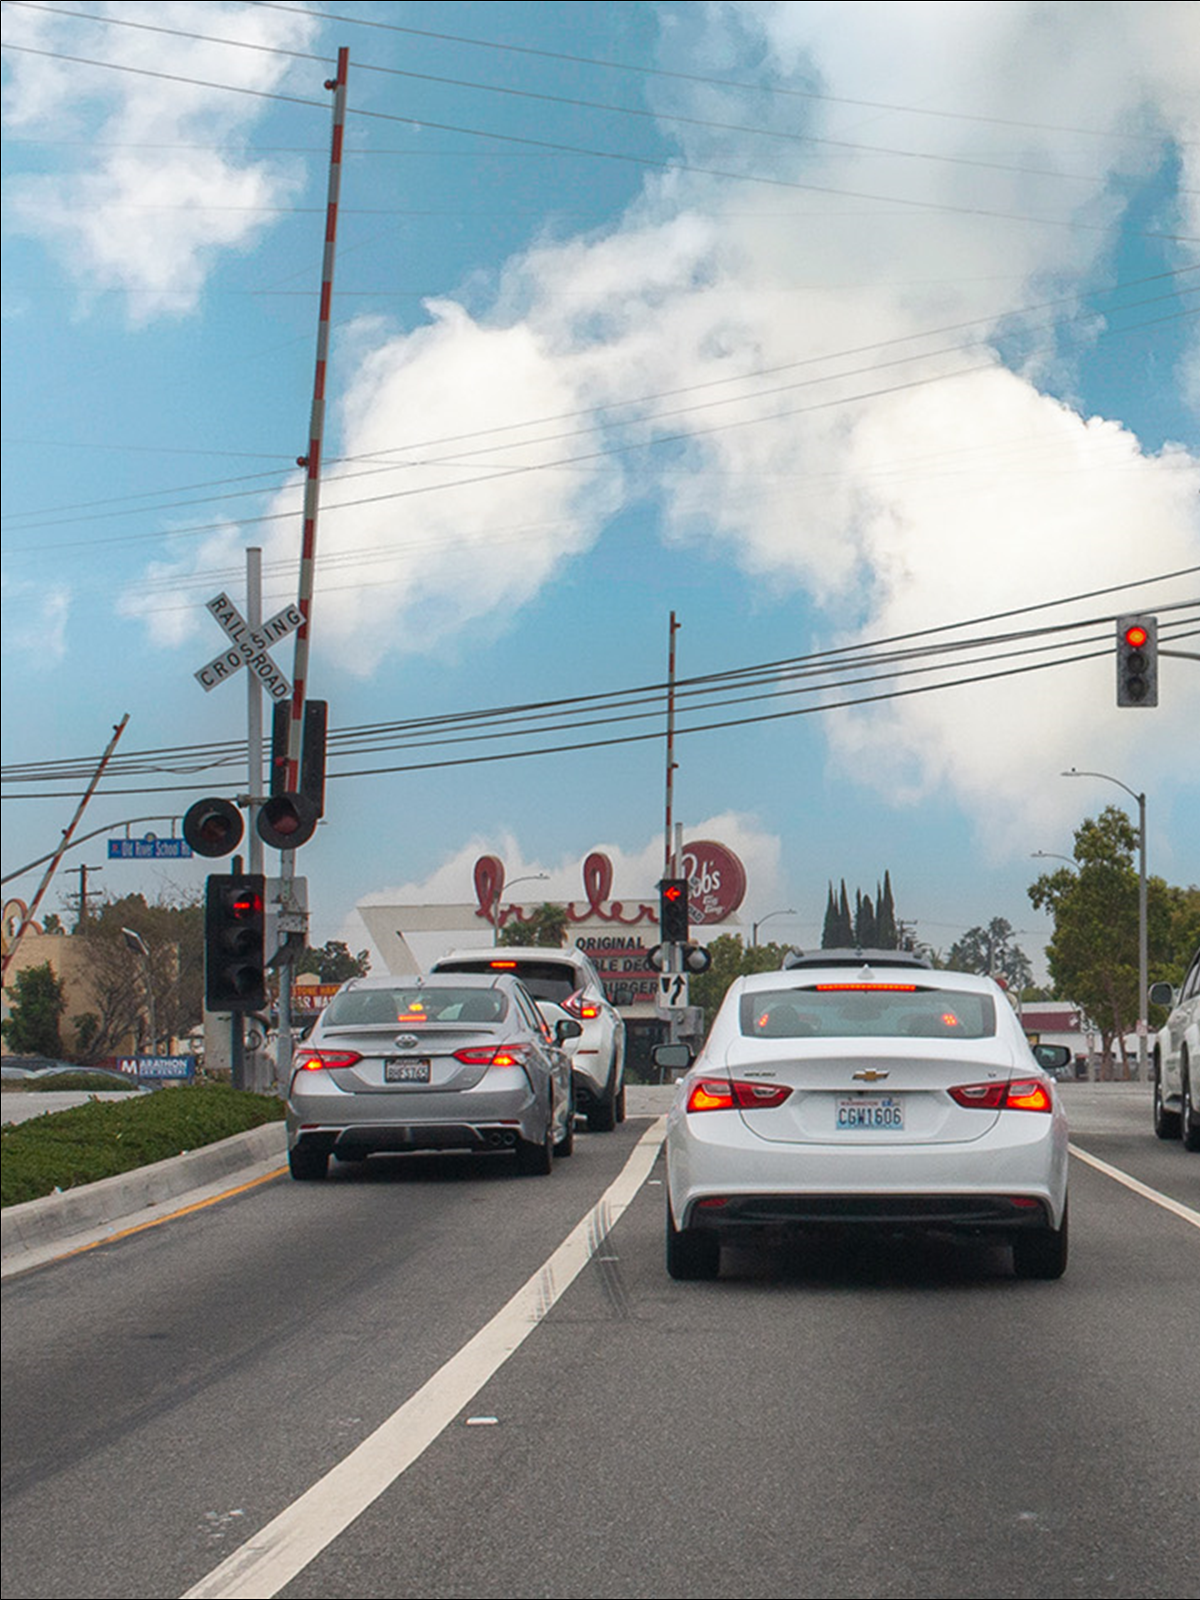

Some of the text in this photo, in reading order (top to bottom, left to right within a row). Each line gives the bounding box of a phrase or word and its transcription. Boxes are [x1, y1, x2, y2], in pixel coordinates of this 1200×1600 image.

[200, 610, 301, 687] CROSSING
[576, 937, 645, 950] ORIGINAL
[623, 958, 650, 972] DEC
[838, 1107, 902, 1125] CGW1606
